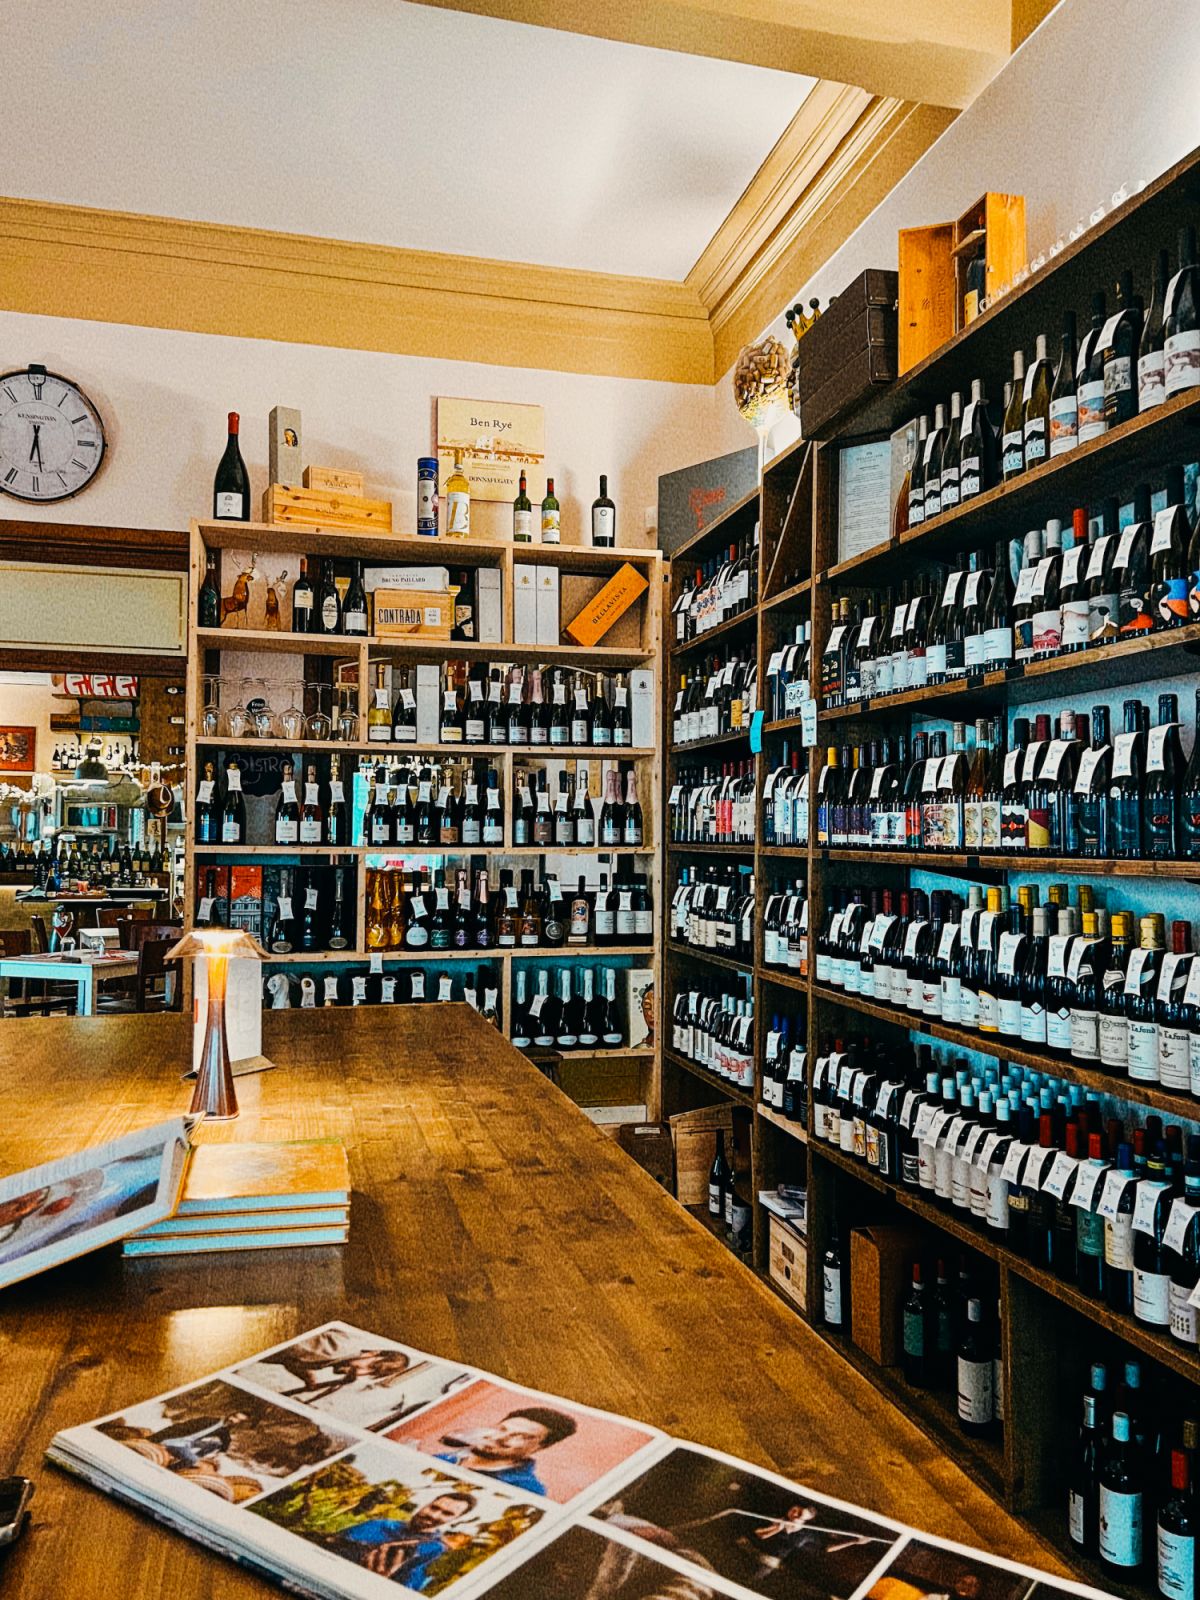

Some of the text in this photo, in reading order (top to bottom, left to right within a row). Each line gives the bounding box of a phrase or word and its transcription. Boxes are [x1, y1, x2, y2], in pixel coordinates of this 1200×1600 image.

[17, 412, 57, 422] KENSINGTON
[470, 417, 512, 432] Ben Ryé
[592, 587, 627, 624] BELLAVISTA
[378, 608, 422, 624] CONTRADA
